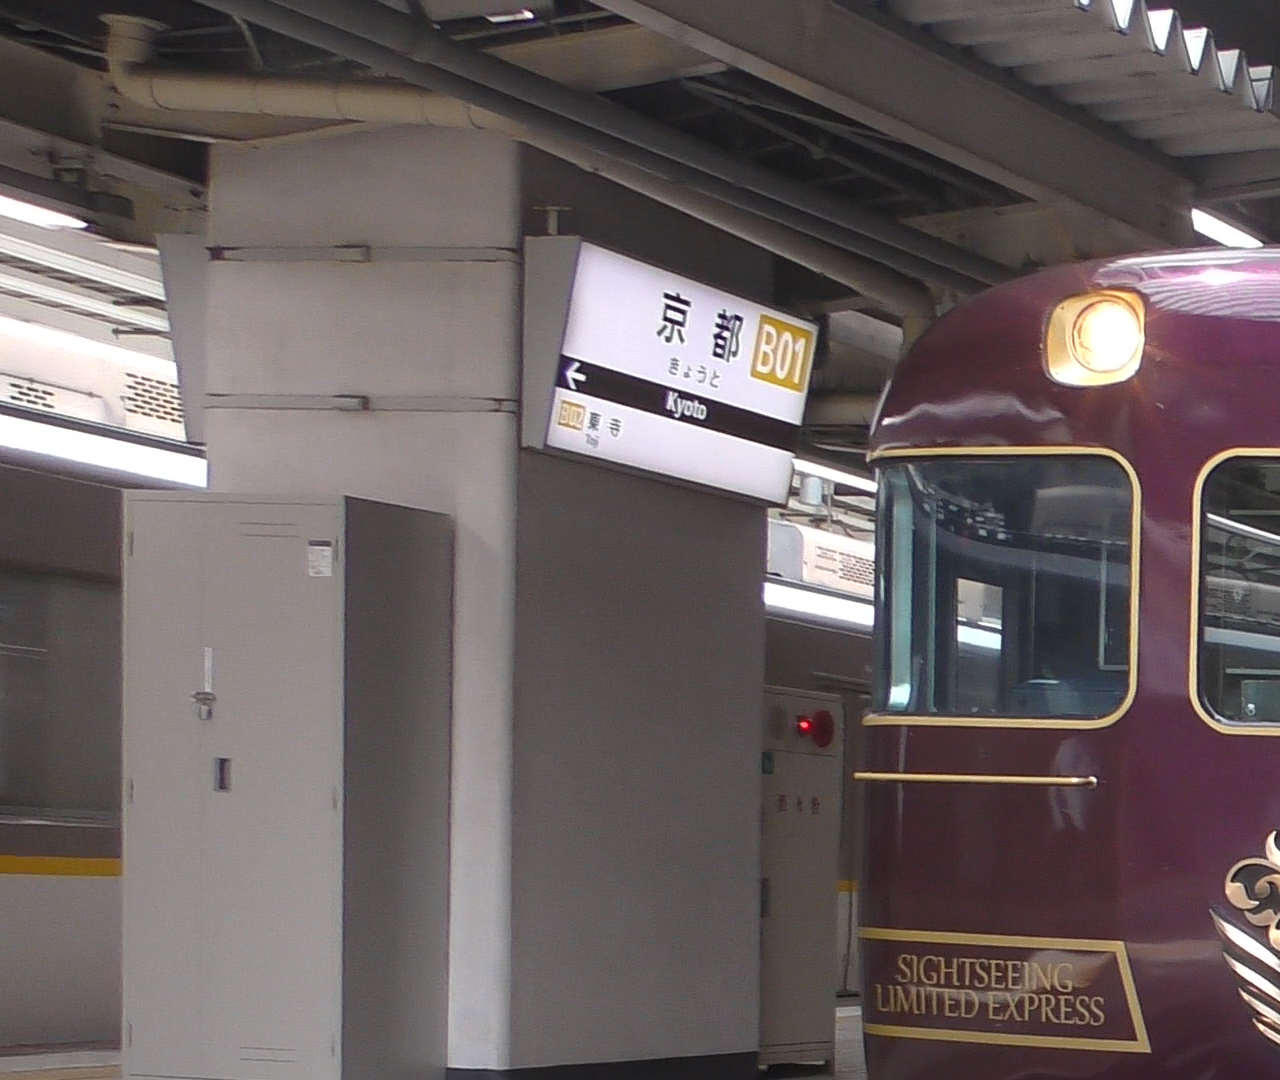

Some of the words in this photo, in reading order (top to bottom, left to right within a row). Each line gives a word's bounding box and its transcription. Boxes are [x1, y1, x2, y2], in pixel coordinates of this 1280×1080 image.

[656, 291, 744, 363] 京都
[668, 357, 720, 388] きょうと
[755, 323, 806, 384] B01
[665, 391, 707, 420] Kyoto
[896, 954, 1074, 993] SIGHTSEEING
[874, 984, 979, 1019] LIMITED
[988, 991, 1105, 1026] EXPRESS
